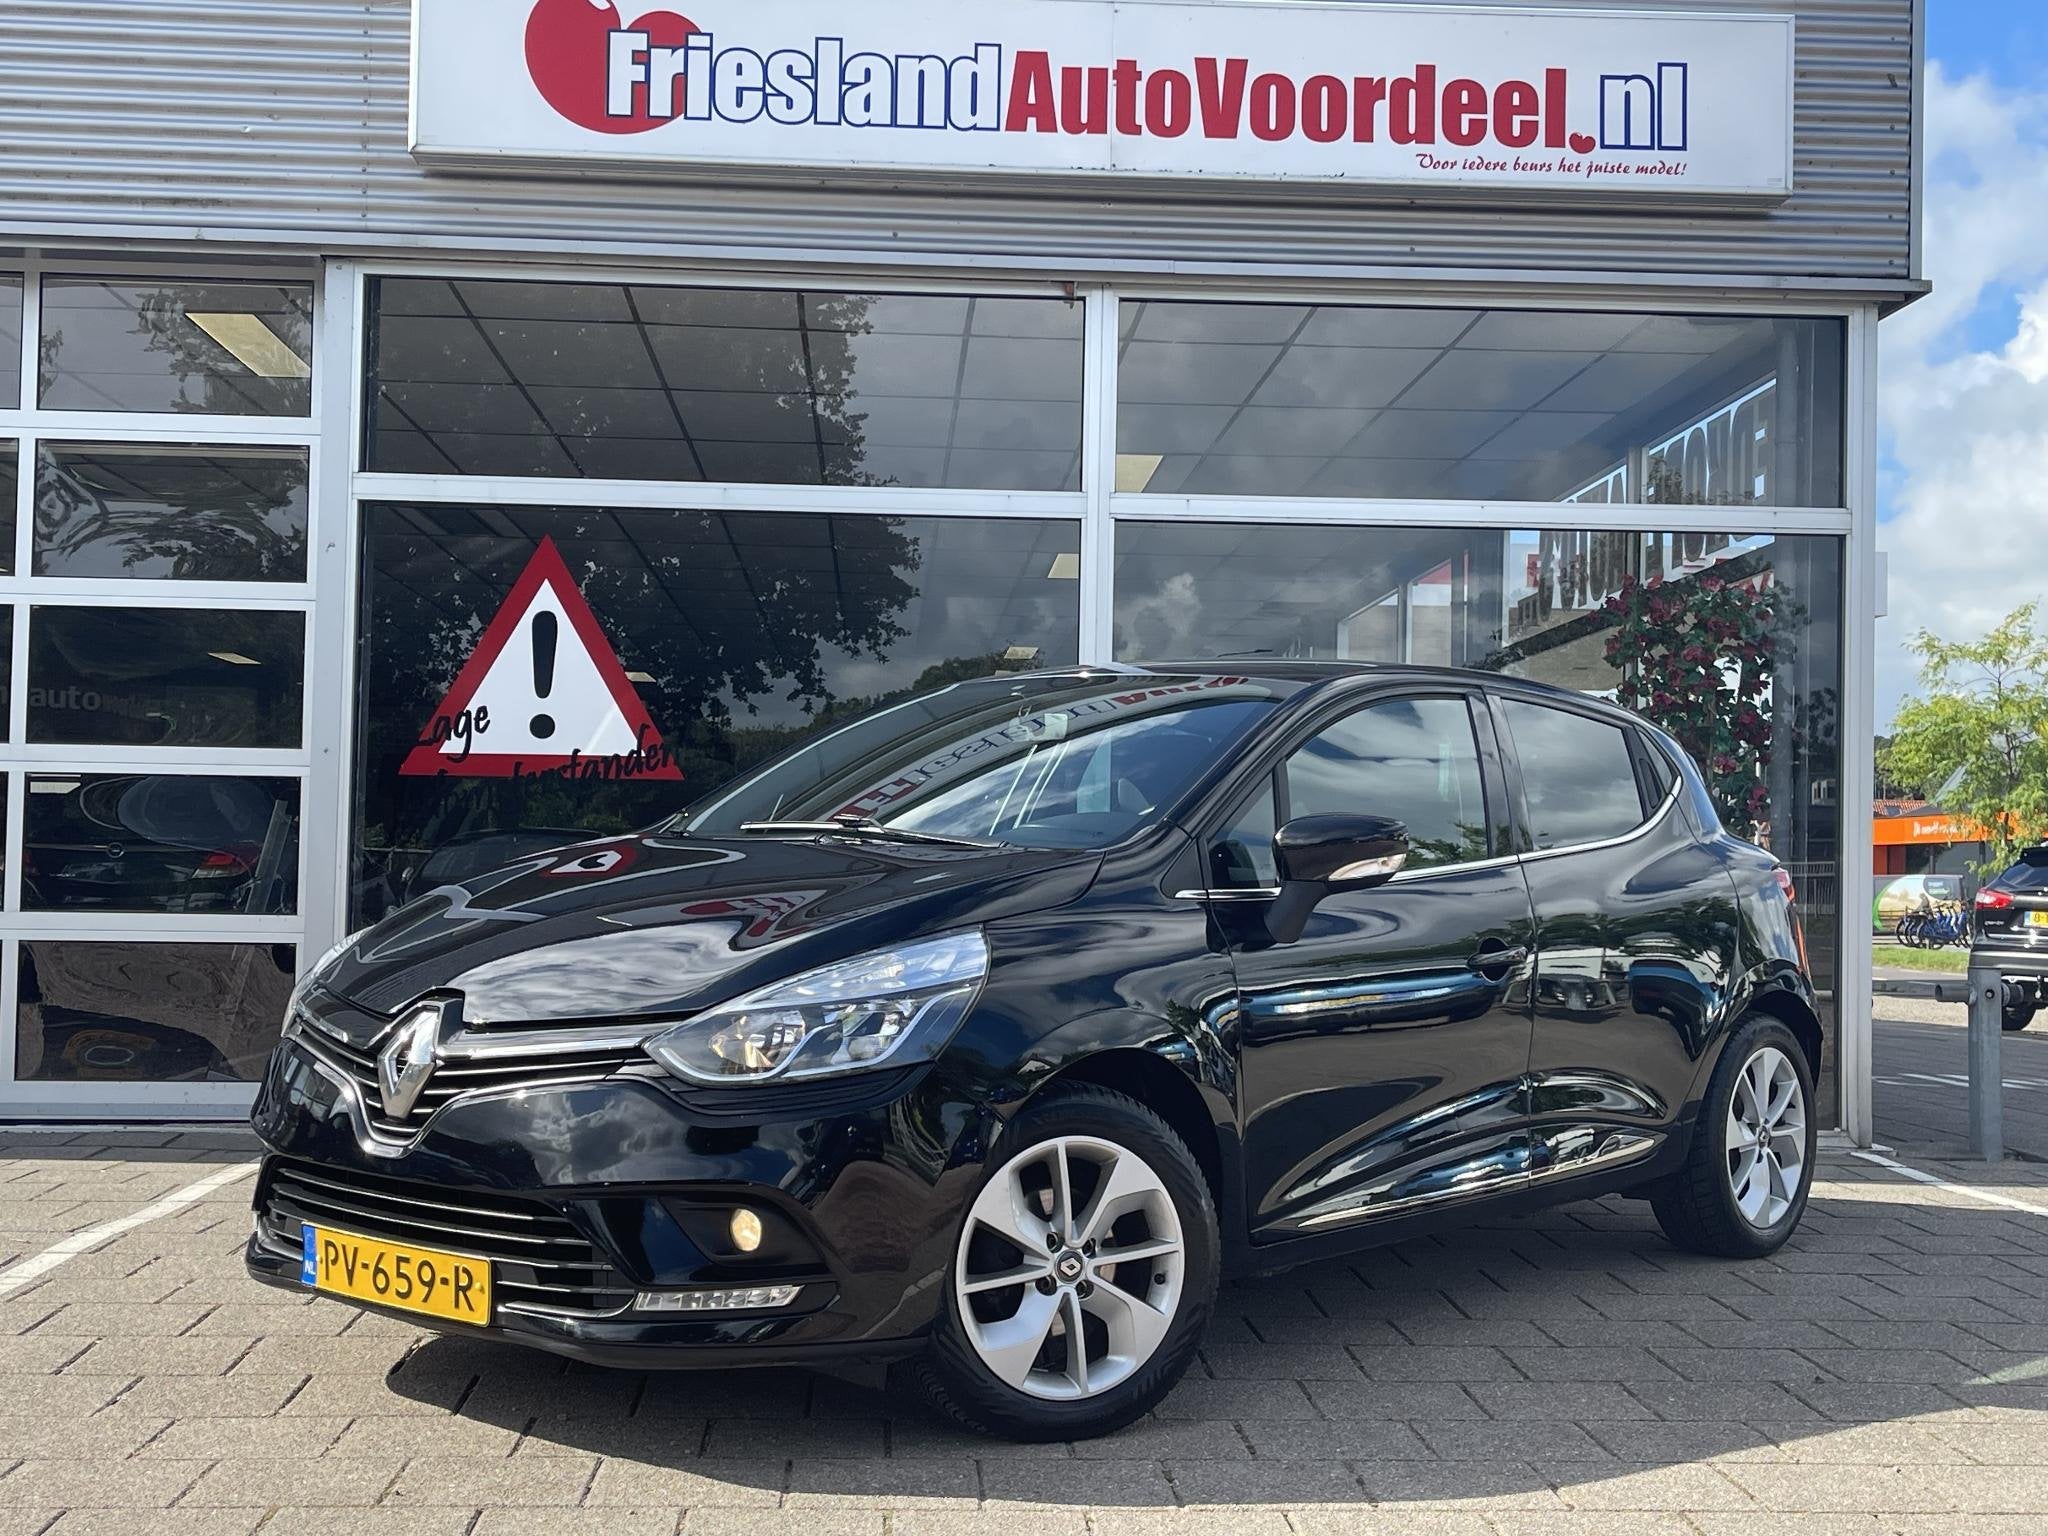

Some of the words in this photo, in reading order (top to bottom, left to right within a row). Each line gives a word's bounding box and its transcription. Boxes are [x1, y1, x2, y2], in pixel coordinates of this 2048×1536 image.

[1415, 153, 1458, 170] Voor
[1462, 158, 1508, 172] iedere
[1513, 156, 1553, 172] beurs
[1557, 156, 1581, 173] het
[1585, 159, 1631, 178] juiste
[1635, 162, 1687, 176] model!
[323, 1239, 475, 1313] PV-659-R
